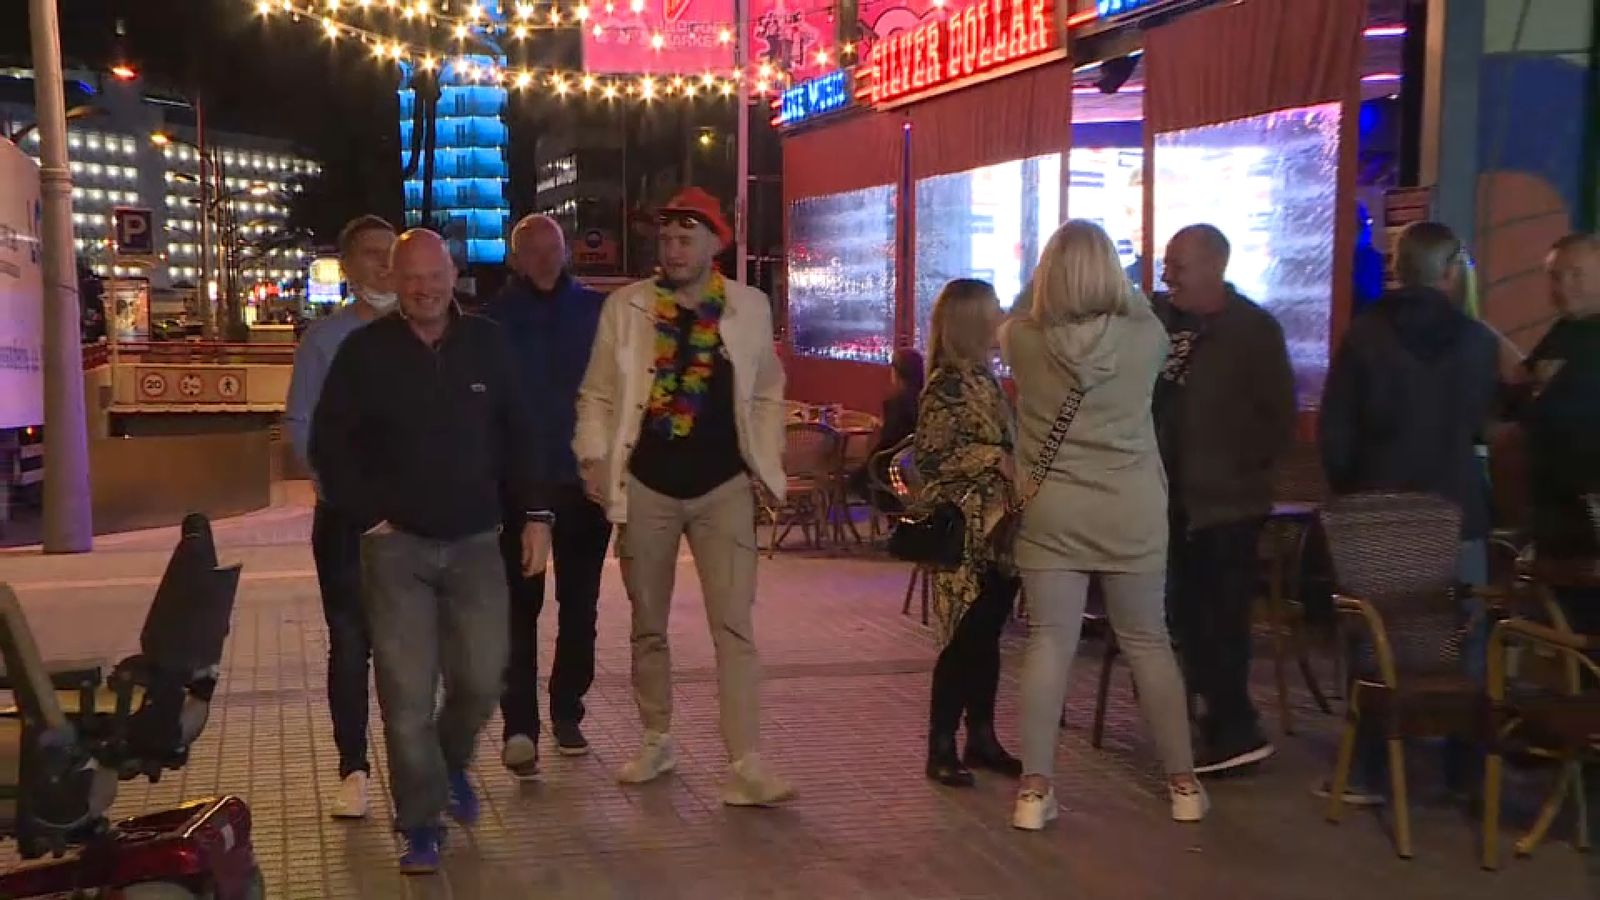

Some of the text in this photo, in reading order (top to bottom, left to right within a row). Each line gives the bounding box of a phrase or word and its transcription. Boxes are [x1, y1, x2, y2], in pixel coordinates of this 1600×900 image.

[872, 0, 1049, 101] SILVER DOLLAR
[124, 214, 147, 245] P
[145, 379, 161, 390] 20
